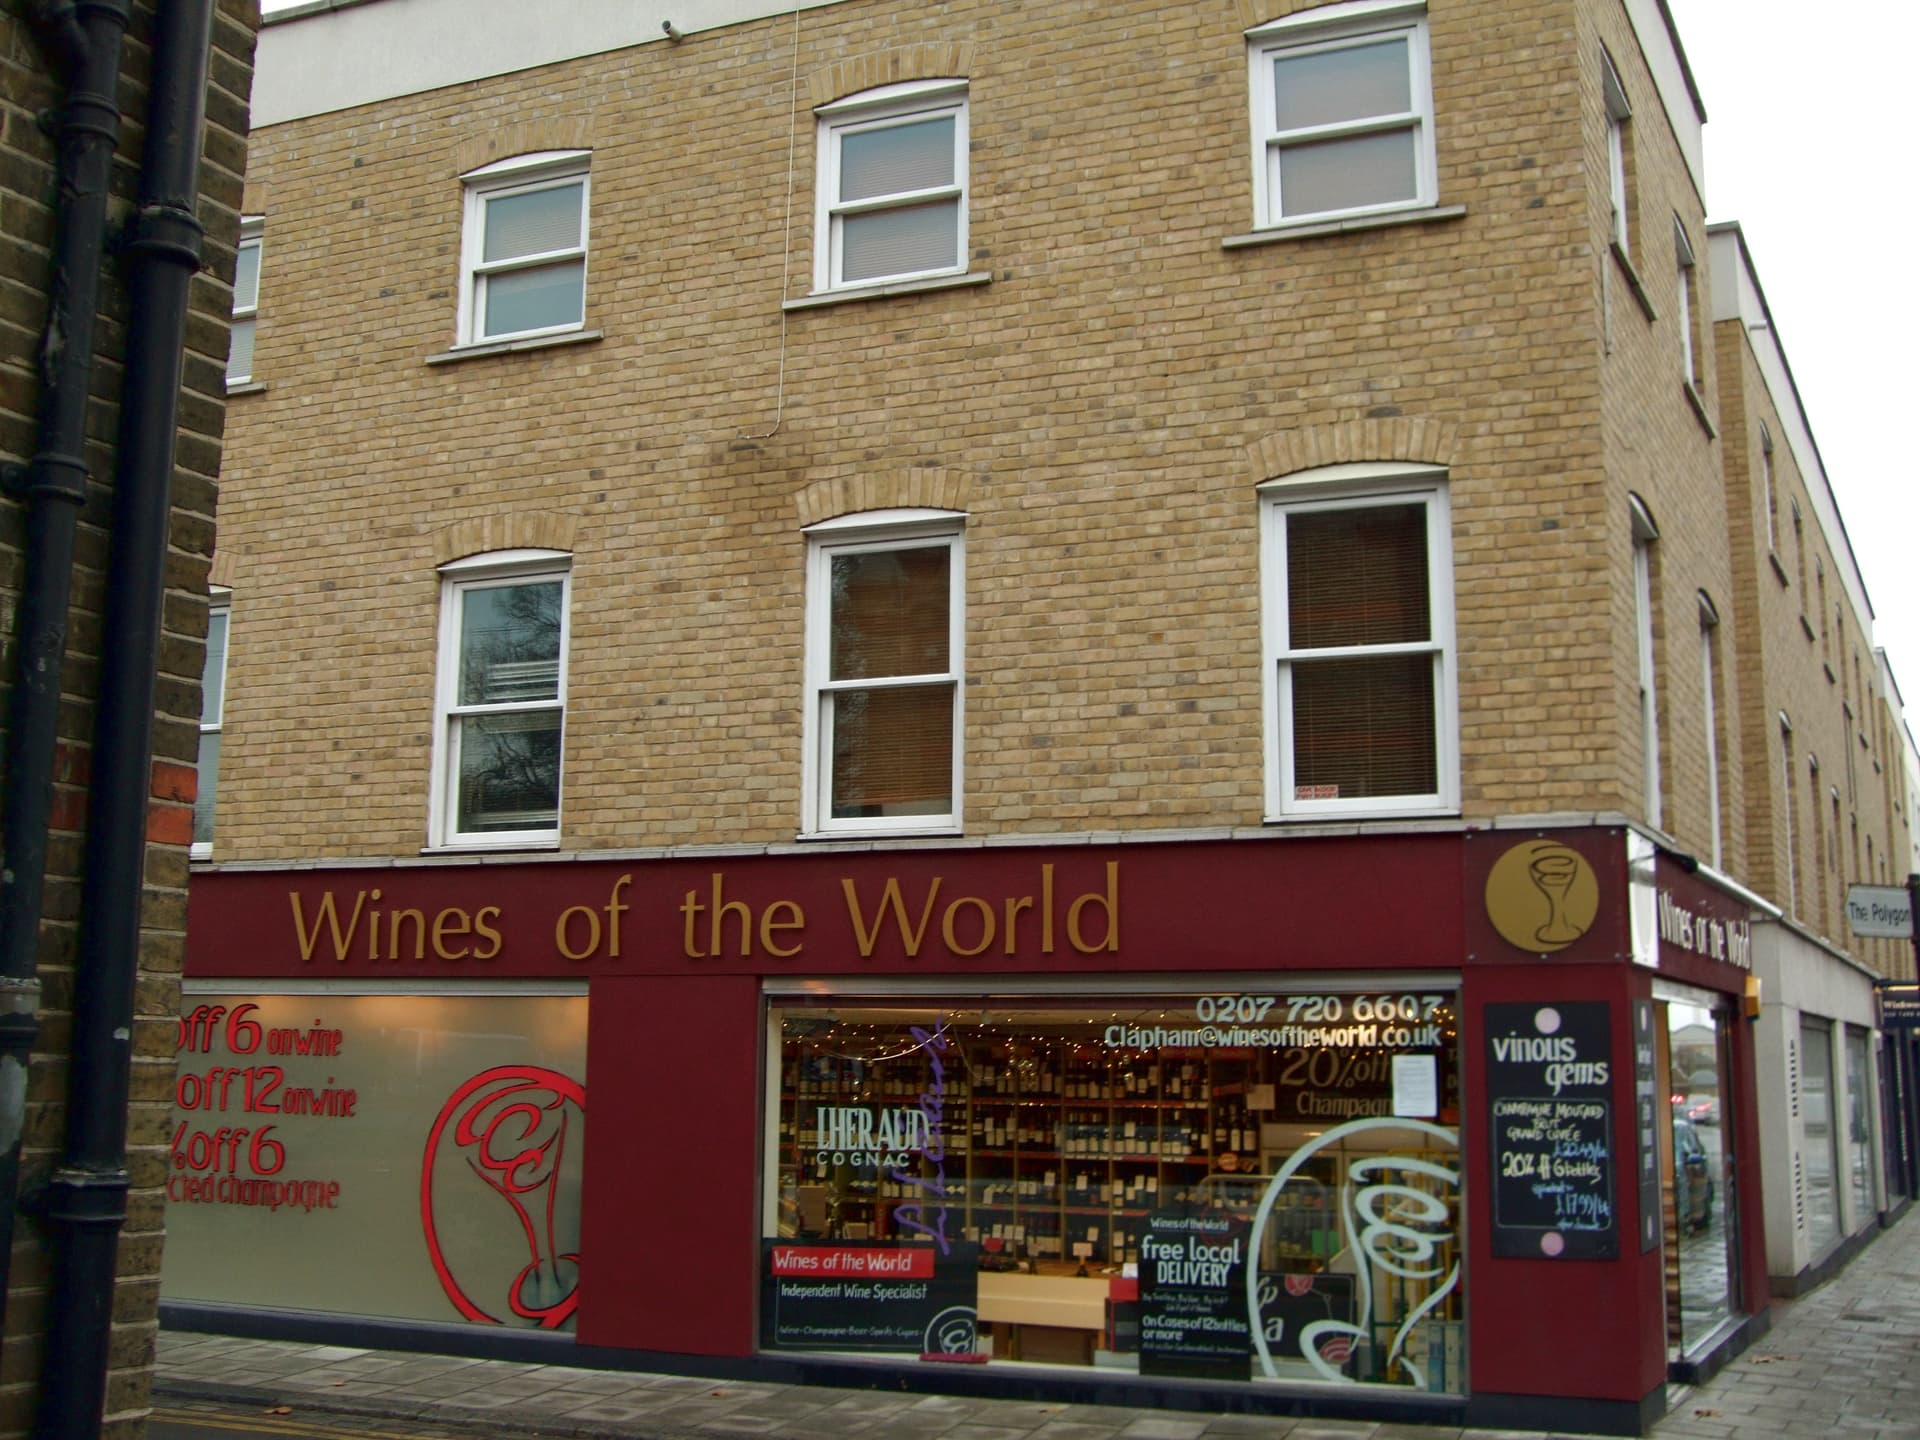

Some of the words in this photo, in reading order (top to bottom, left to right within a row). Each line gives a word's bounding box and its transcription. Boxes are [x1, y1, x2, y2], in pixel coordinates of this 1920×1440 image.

[290, 888, 502, 962] Wines
[555, 873, 631, 961] of
[680, 871, 806, 959] the
[842, 860, 1121, 959] World
[1848, 902, 1868, 921] The
[1872, 903, 1910, 926] Polygon
[1659, 890, 1693, 949] Wines
[1710, 919, 1724, 961] the
[1726, 920, 1750, 969] World
[1196, 996, 1275, 1022] 0207
[1286, 996, 1342, 1022] 720
[1352, 996, 1443, 1021] 6607
[225, 1003, 263, 1054] 6
[1105, 1025, 1442, 1052] Clapham@winesoftheworld.co.uk
[1492, 1030, 1577, 1062] vinous
[176, 1066, 241, 1111] off
[241, 1065, 285, 1114] 12
[1544, 1061, 1609, 1096] gems
[816, 1107, 930, 1151] LHERAUD
[249, 1124, 286, 1175] 6
[816, 1151, 910, 1168] COGNAC
[217, 1175, 340, 1212] champagne
[1151, 1217, 1178, 1229] Wines
[1203, 1220, 1229, 1231] World
[774, 1250, 818, 1269] Wines
[823, 1252, 841, 1269] of
[842, 1253, 864, 1270] the
[867, 1253, 912, 1272] World
[1141, 1235, 1184, 1260] free
[1189, 1236, 1241, 1264] local
[1157, 1261, 1231, 1287] DELIVERY
[781, 1283, 841, 1300] Independent
[844, 1284, 871, 1299] Wine
[873, 1284, 927, 1302] Specialist
[1142, 1316, 1156, 1327] On
[1157, 1315, 1189, 1328] Cases
[1189, 1317, 1200, 1328] of
[1142, 1330, 1155, 1339] or
[1156, 1330, 1183, 1341] more
